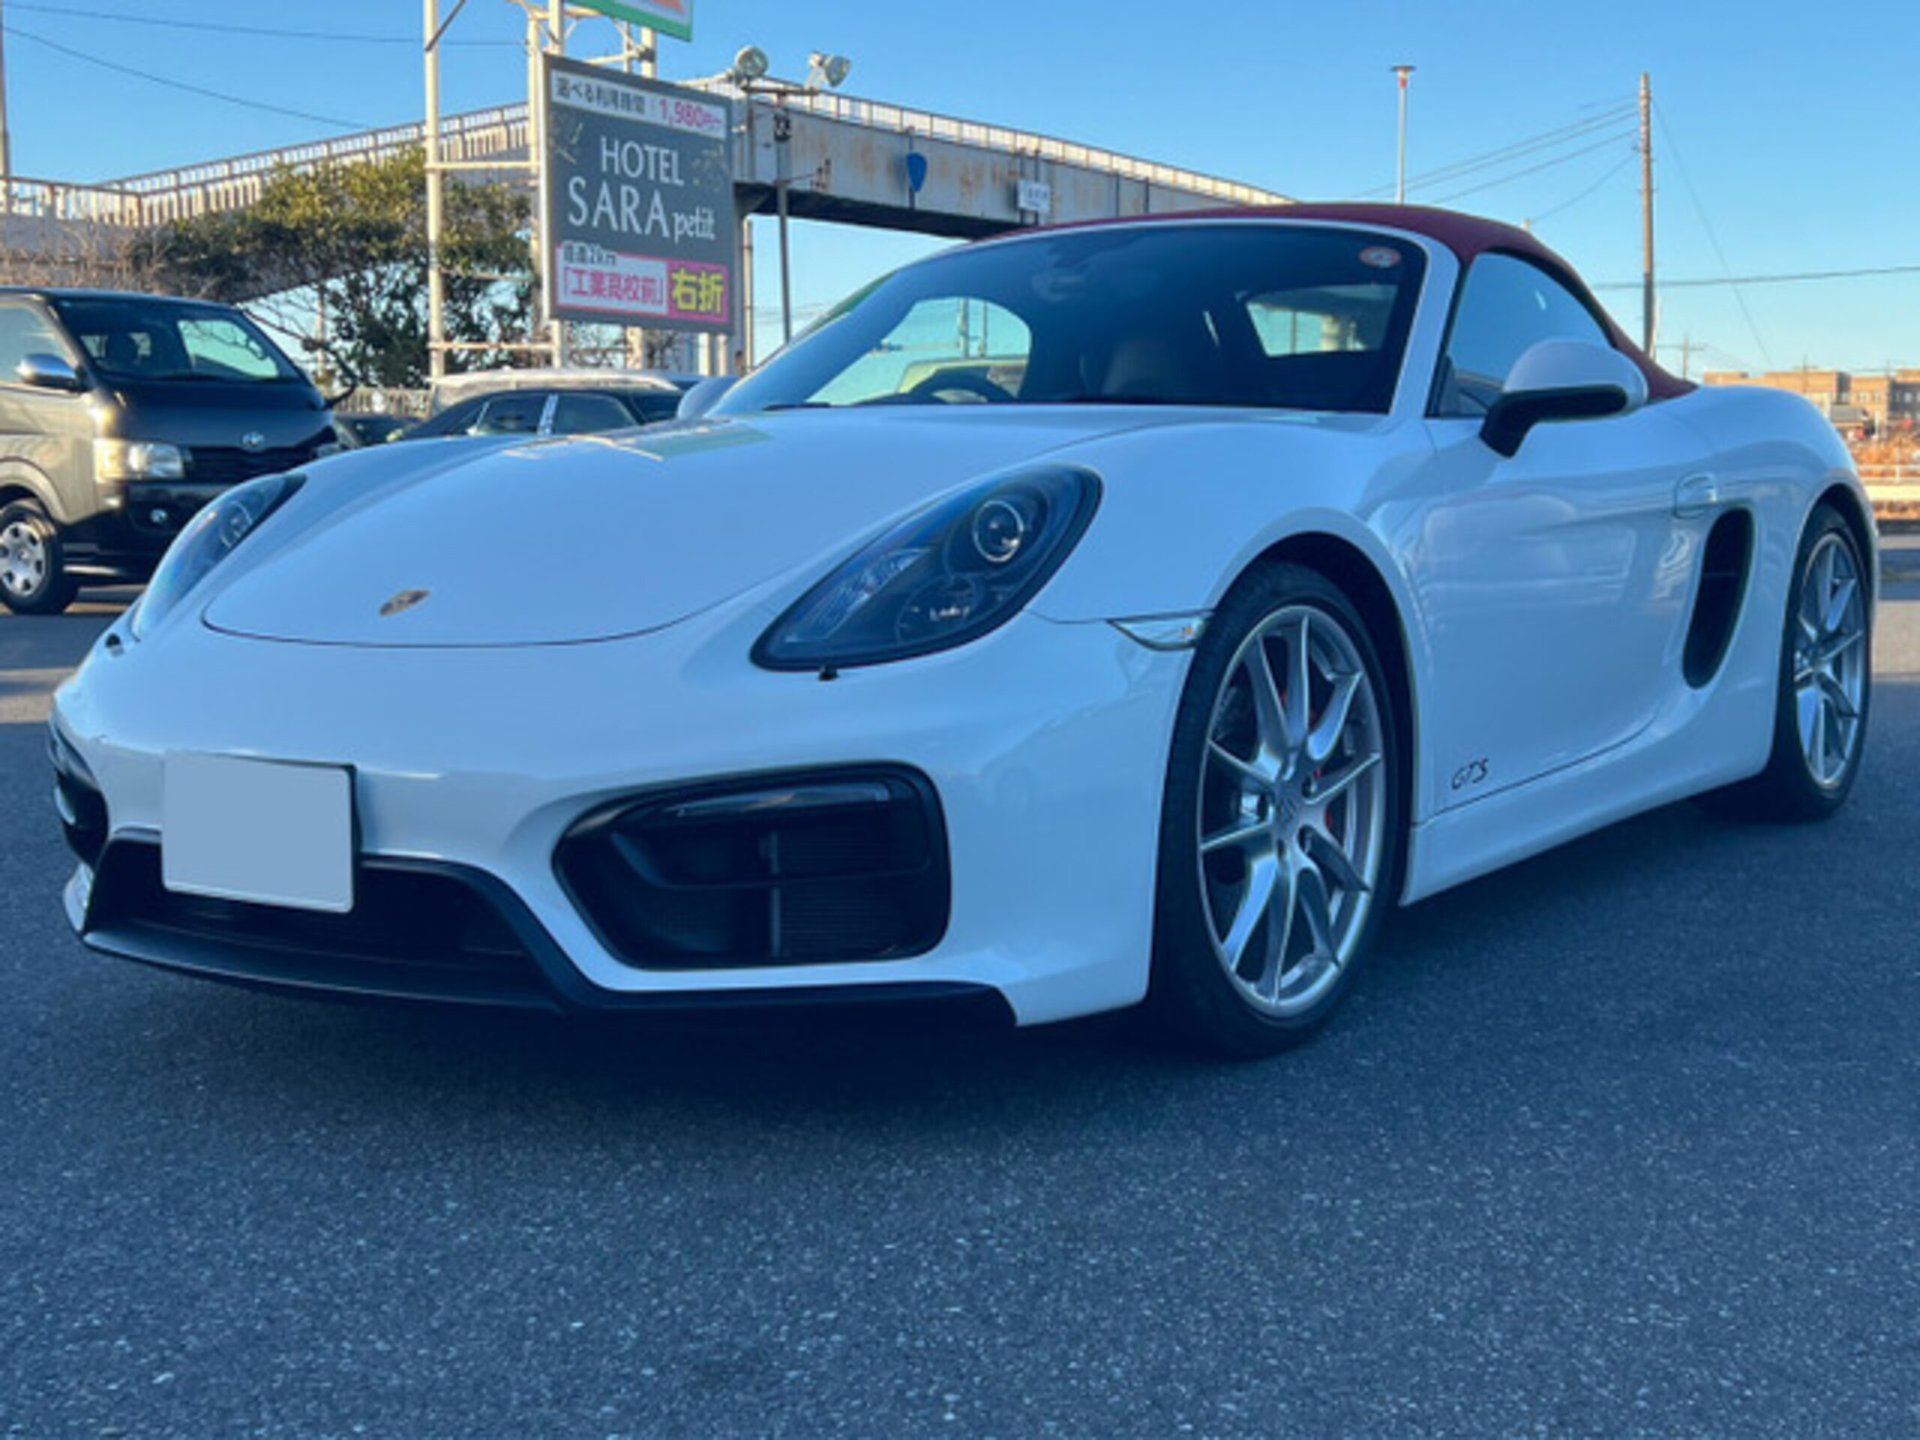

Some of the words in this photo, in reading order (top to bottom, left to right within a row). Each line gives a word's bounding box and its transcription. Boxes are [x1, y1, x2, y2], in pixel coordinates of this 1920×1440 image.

[601, 135, 684, 187] HOTEL
[568, 176, 670, 238] SARA
[672, 205, 715, 243] petit
[671, 267, 724, 313] 右折
[1451, 758, 1488, 790] GTS
